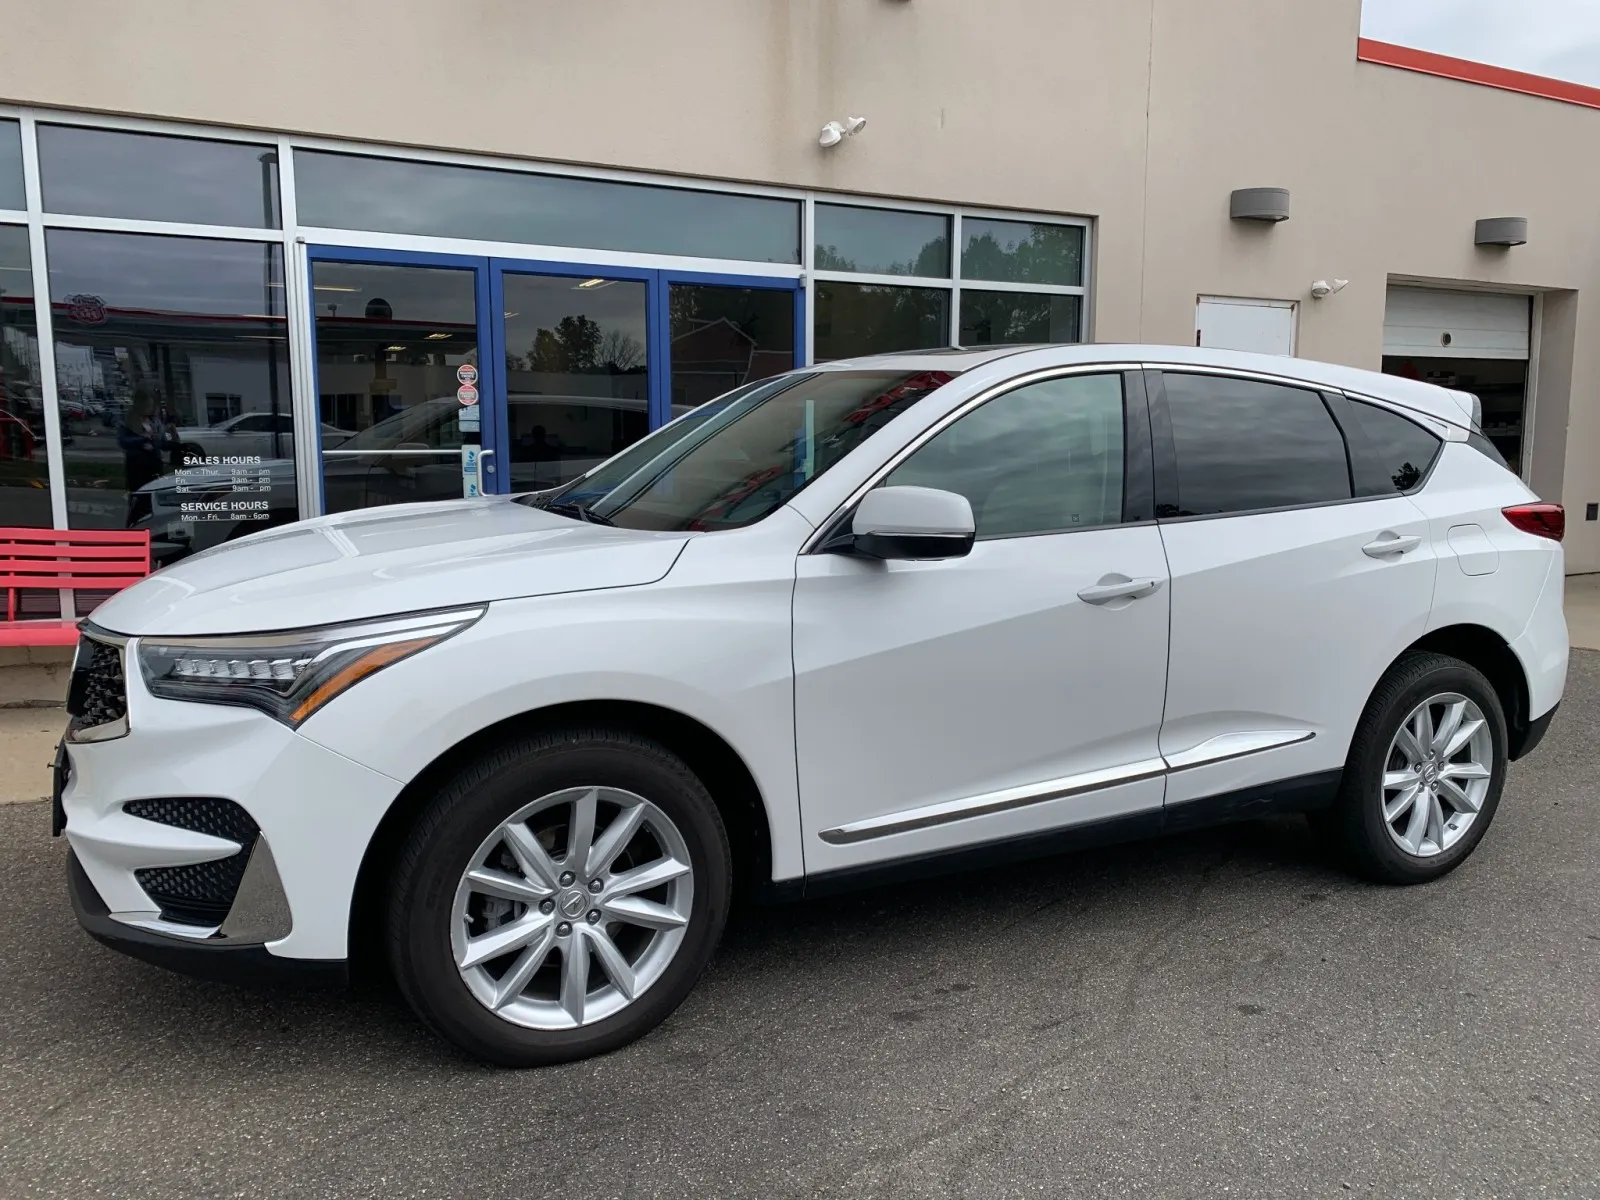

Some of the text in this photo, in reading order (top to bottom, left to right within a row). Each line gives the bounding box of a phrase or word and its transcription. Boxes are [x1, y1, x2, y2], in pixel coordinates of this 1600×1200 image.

[223, 456, 260, 464] HOURS
[181, 501, 268, 511] SERVICE HOURS
